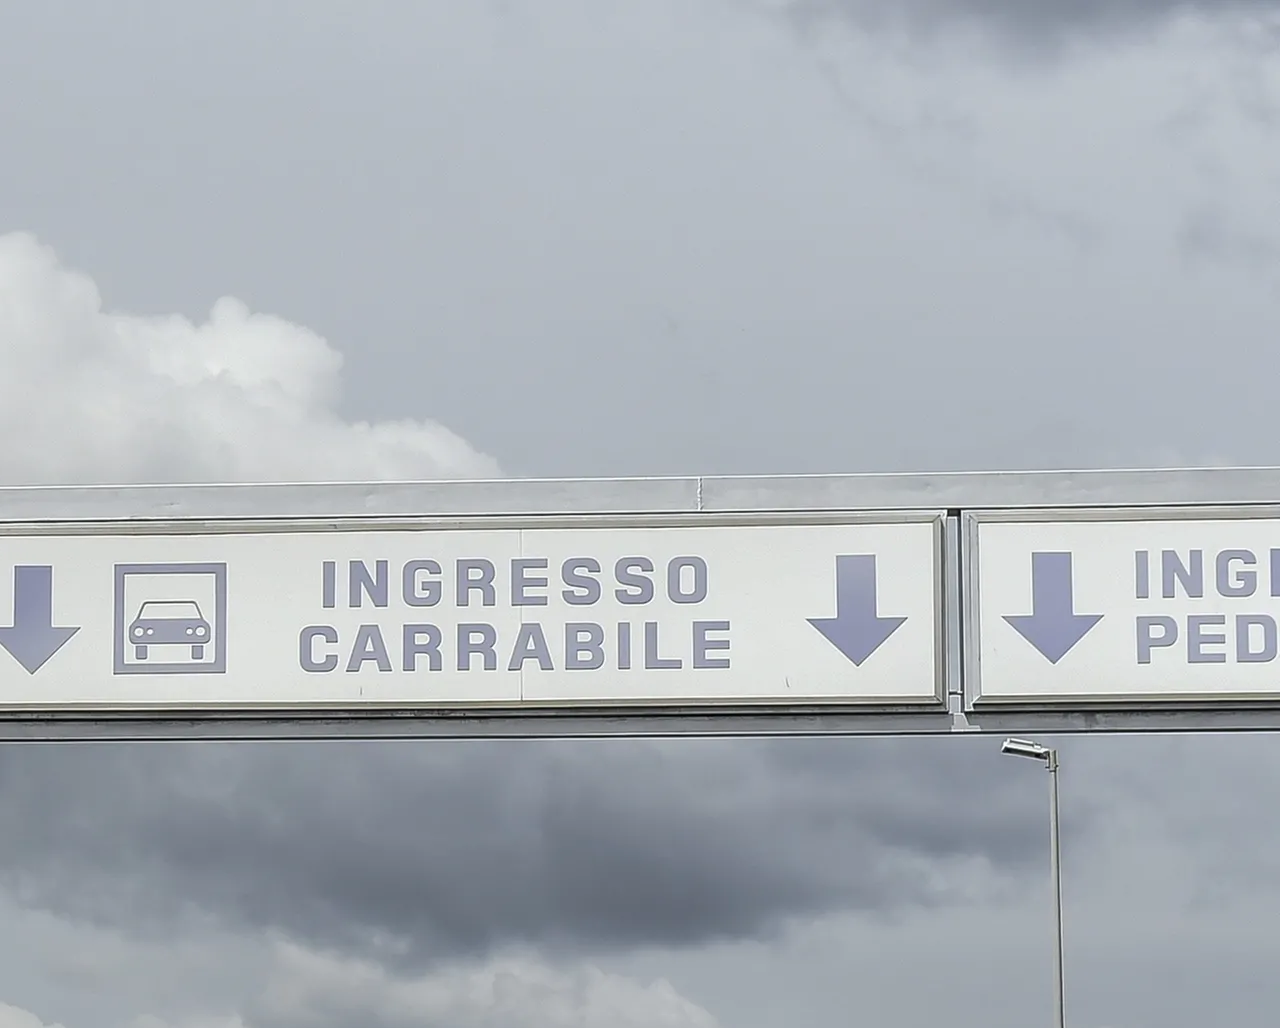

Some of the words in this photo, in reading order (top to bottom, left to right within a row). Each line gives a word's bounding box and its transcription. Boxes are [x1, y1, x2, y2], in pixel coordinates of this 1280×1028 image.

[321, 555, 709, 609] INGRESSO
[1134, 548, 1280, 599] ING
[298, 621, 733, 673] CARRABILE
[1136, 614, 1278, 664] PED
